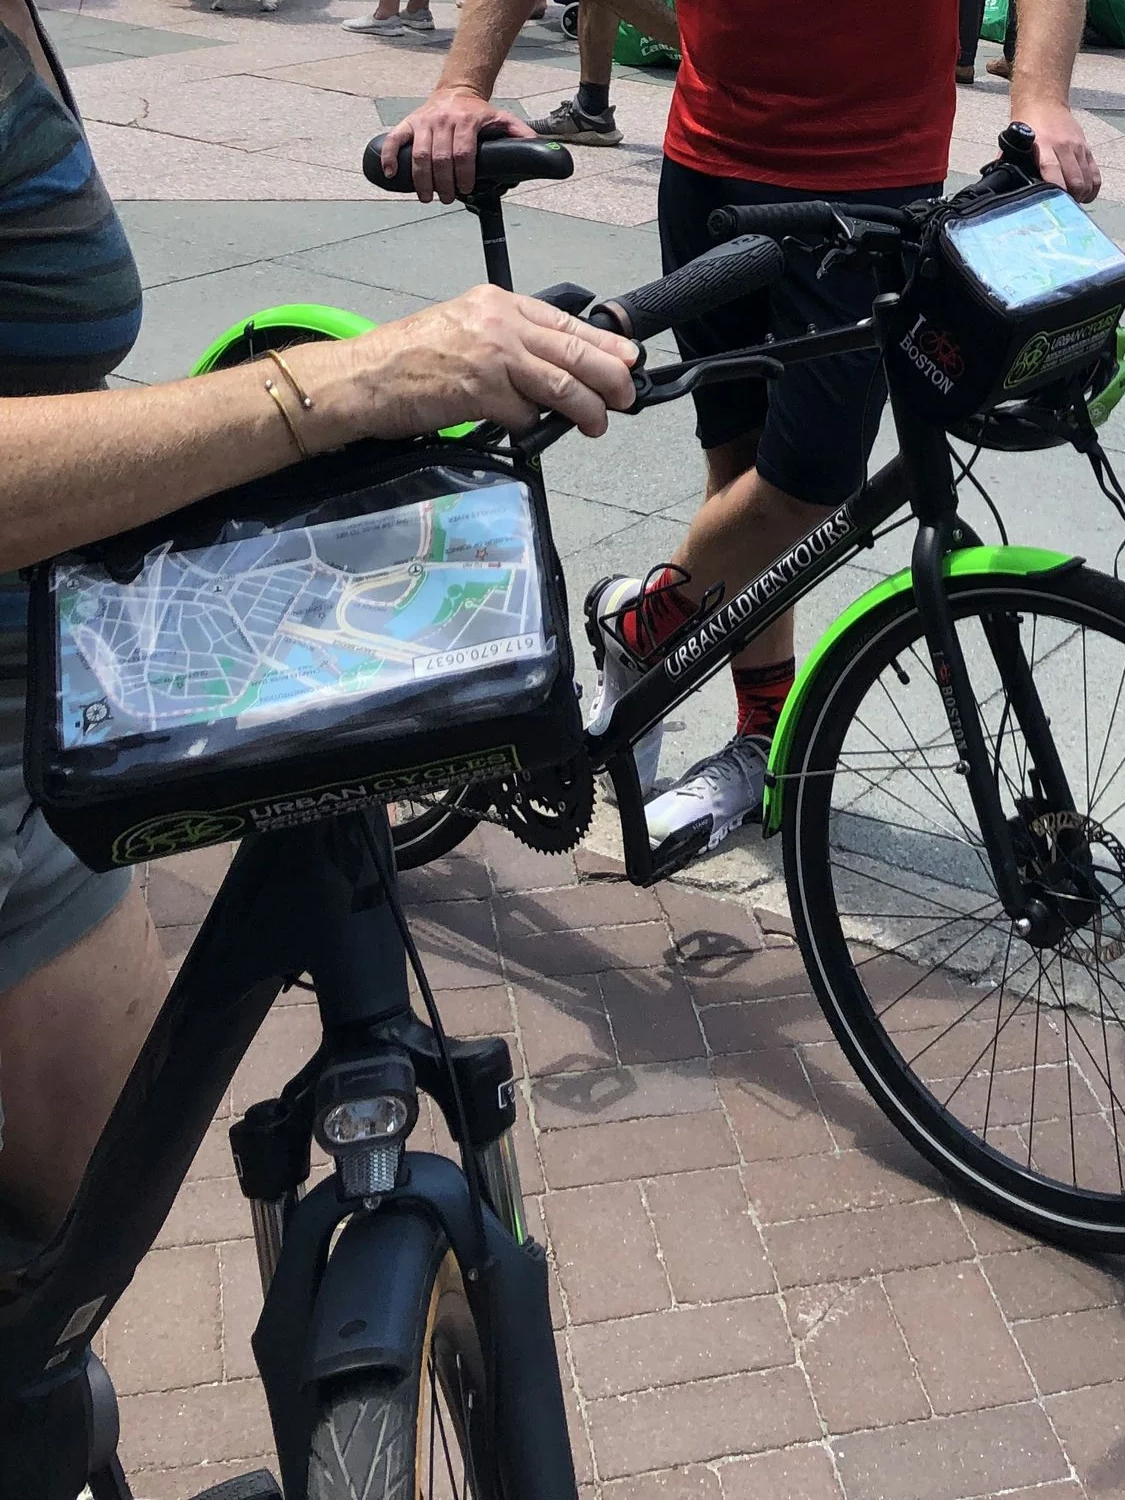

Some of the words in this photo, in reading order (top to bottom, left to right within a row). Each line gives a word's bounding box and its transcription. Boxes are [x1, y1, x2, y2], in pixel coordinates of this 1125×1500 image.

[909, 313, 927, 338] I
[899, 334, 954, 396] BOSTON
[665, 615, 728, 677] URBAN
[726, 509, 851, 630] ADVENTOURS
[425, 637, 535, 671] 617.670.0637
[941, 685, 969, 751] BOSTON
[250, 784, 367, 820] URBAN
[373, 752, 507, 791] CYCLES
